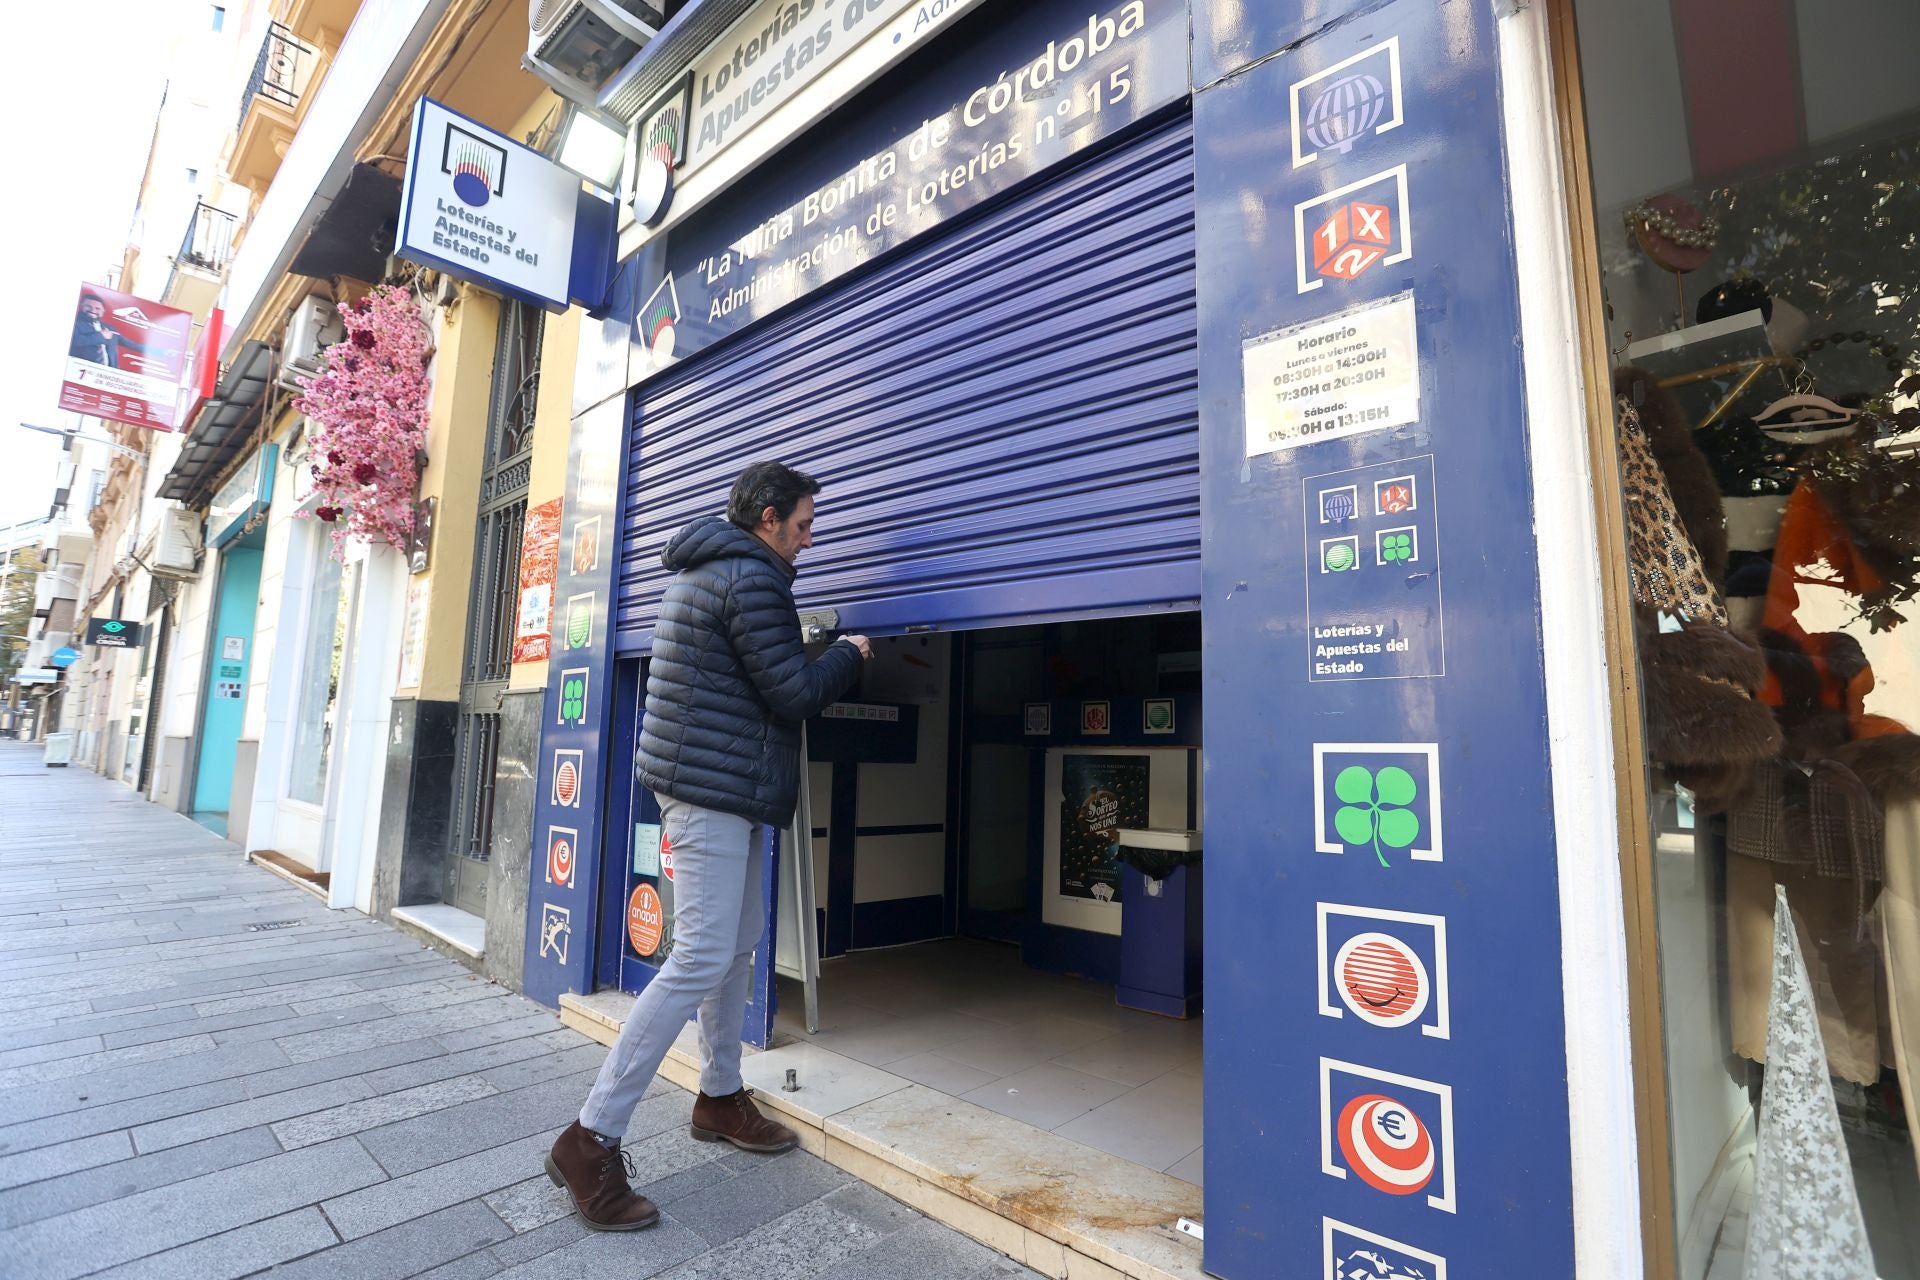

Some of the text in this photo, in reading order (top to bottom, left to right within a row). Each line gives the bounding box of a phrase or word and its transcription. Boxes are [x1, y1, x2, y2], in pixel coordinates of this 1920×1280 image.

[700, 0, 815, 108] Loterías
[697, 19, 832, 154] Apuestas
[738, 212, 793, 266] Niña
[803, 151, 896, 227] Bonita
[908, 119, 950, 162] de
[963, 0, 1145, 128] Córdoba
[708, 225, 858, 324] Administración
[866, 203, 896, 236] de
[907, 131, 1023, 215] Loterías
[1087, 64, 1131, 115] 15
[437, 197, 517, 243] Loterías y
[433, 232, 490, 264] Estado
[435, 215, 538, 267] Apuestas del
[1297, 326, 1357, 351] Horario
[1273, 348, 1387, 386] 08:30H a 14:00H
[1286, 341, 1369, 369] Lunes a viernes
[1276, 367, 1386, 403] 17:30H a 20:30H
[1304, 401, 1347, 418] Sábado:
[1324, 419, 1335, 431] a
[1338, 406, 1390, 428] 13:15H
[1314, 622, 1385, 639] Loterías y
[1316, 638, 1409, 659] Apuestas del
[1316, 661, 1364, 675] Estado
[1090, 821, 1102, 832] NOS
[1103, 816, 1117, 828] UNE
[632, 907, 658, 925] anapal
